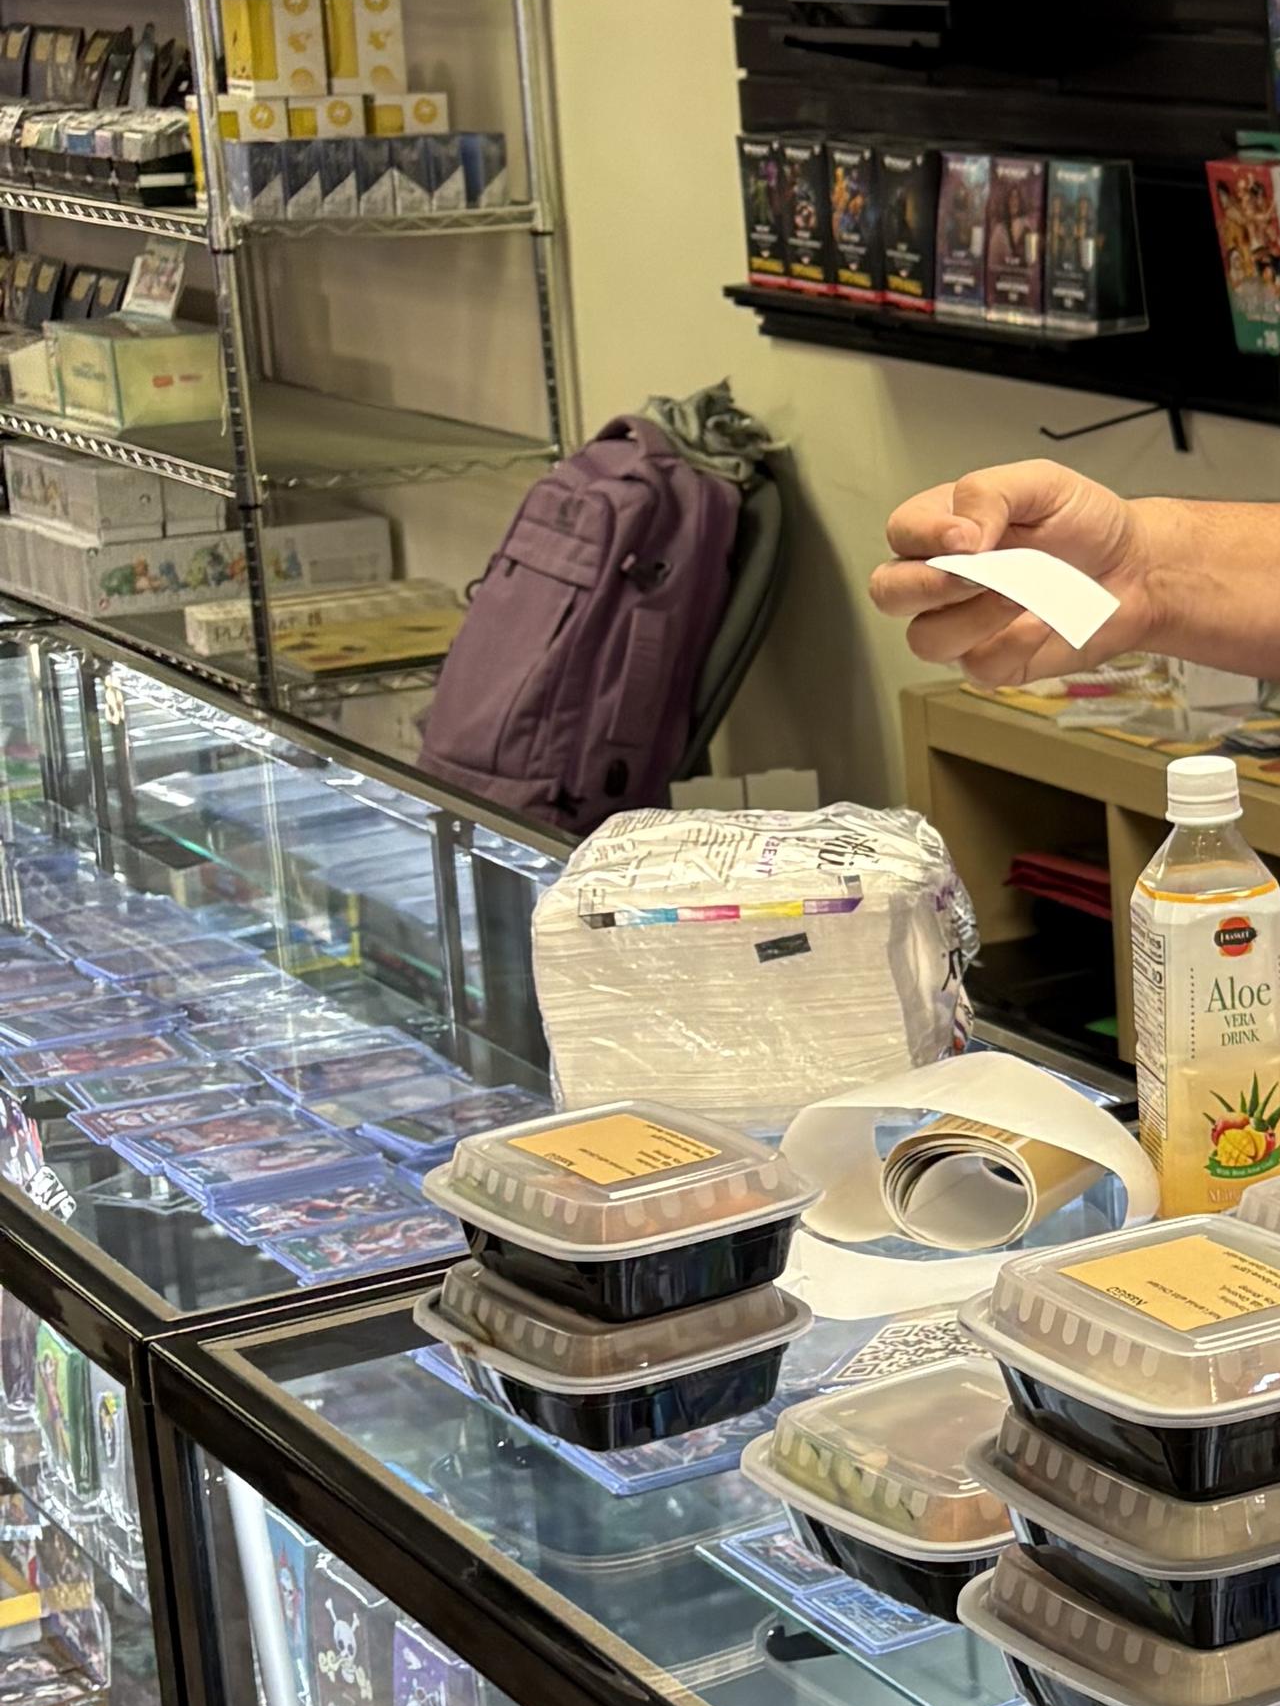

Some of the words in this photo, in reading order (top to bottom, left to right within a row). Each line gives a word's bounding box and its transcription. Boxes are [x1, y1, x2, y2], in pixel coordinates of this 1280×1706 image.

[1205, 976, 1273, 1014] Aloe
[1223, 1013, 1256, 1029] VERA
[1221, 1030, 1260, 1047] DRINK
